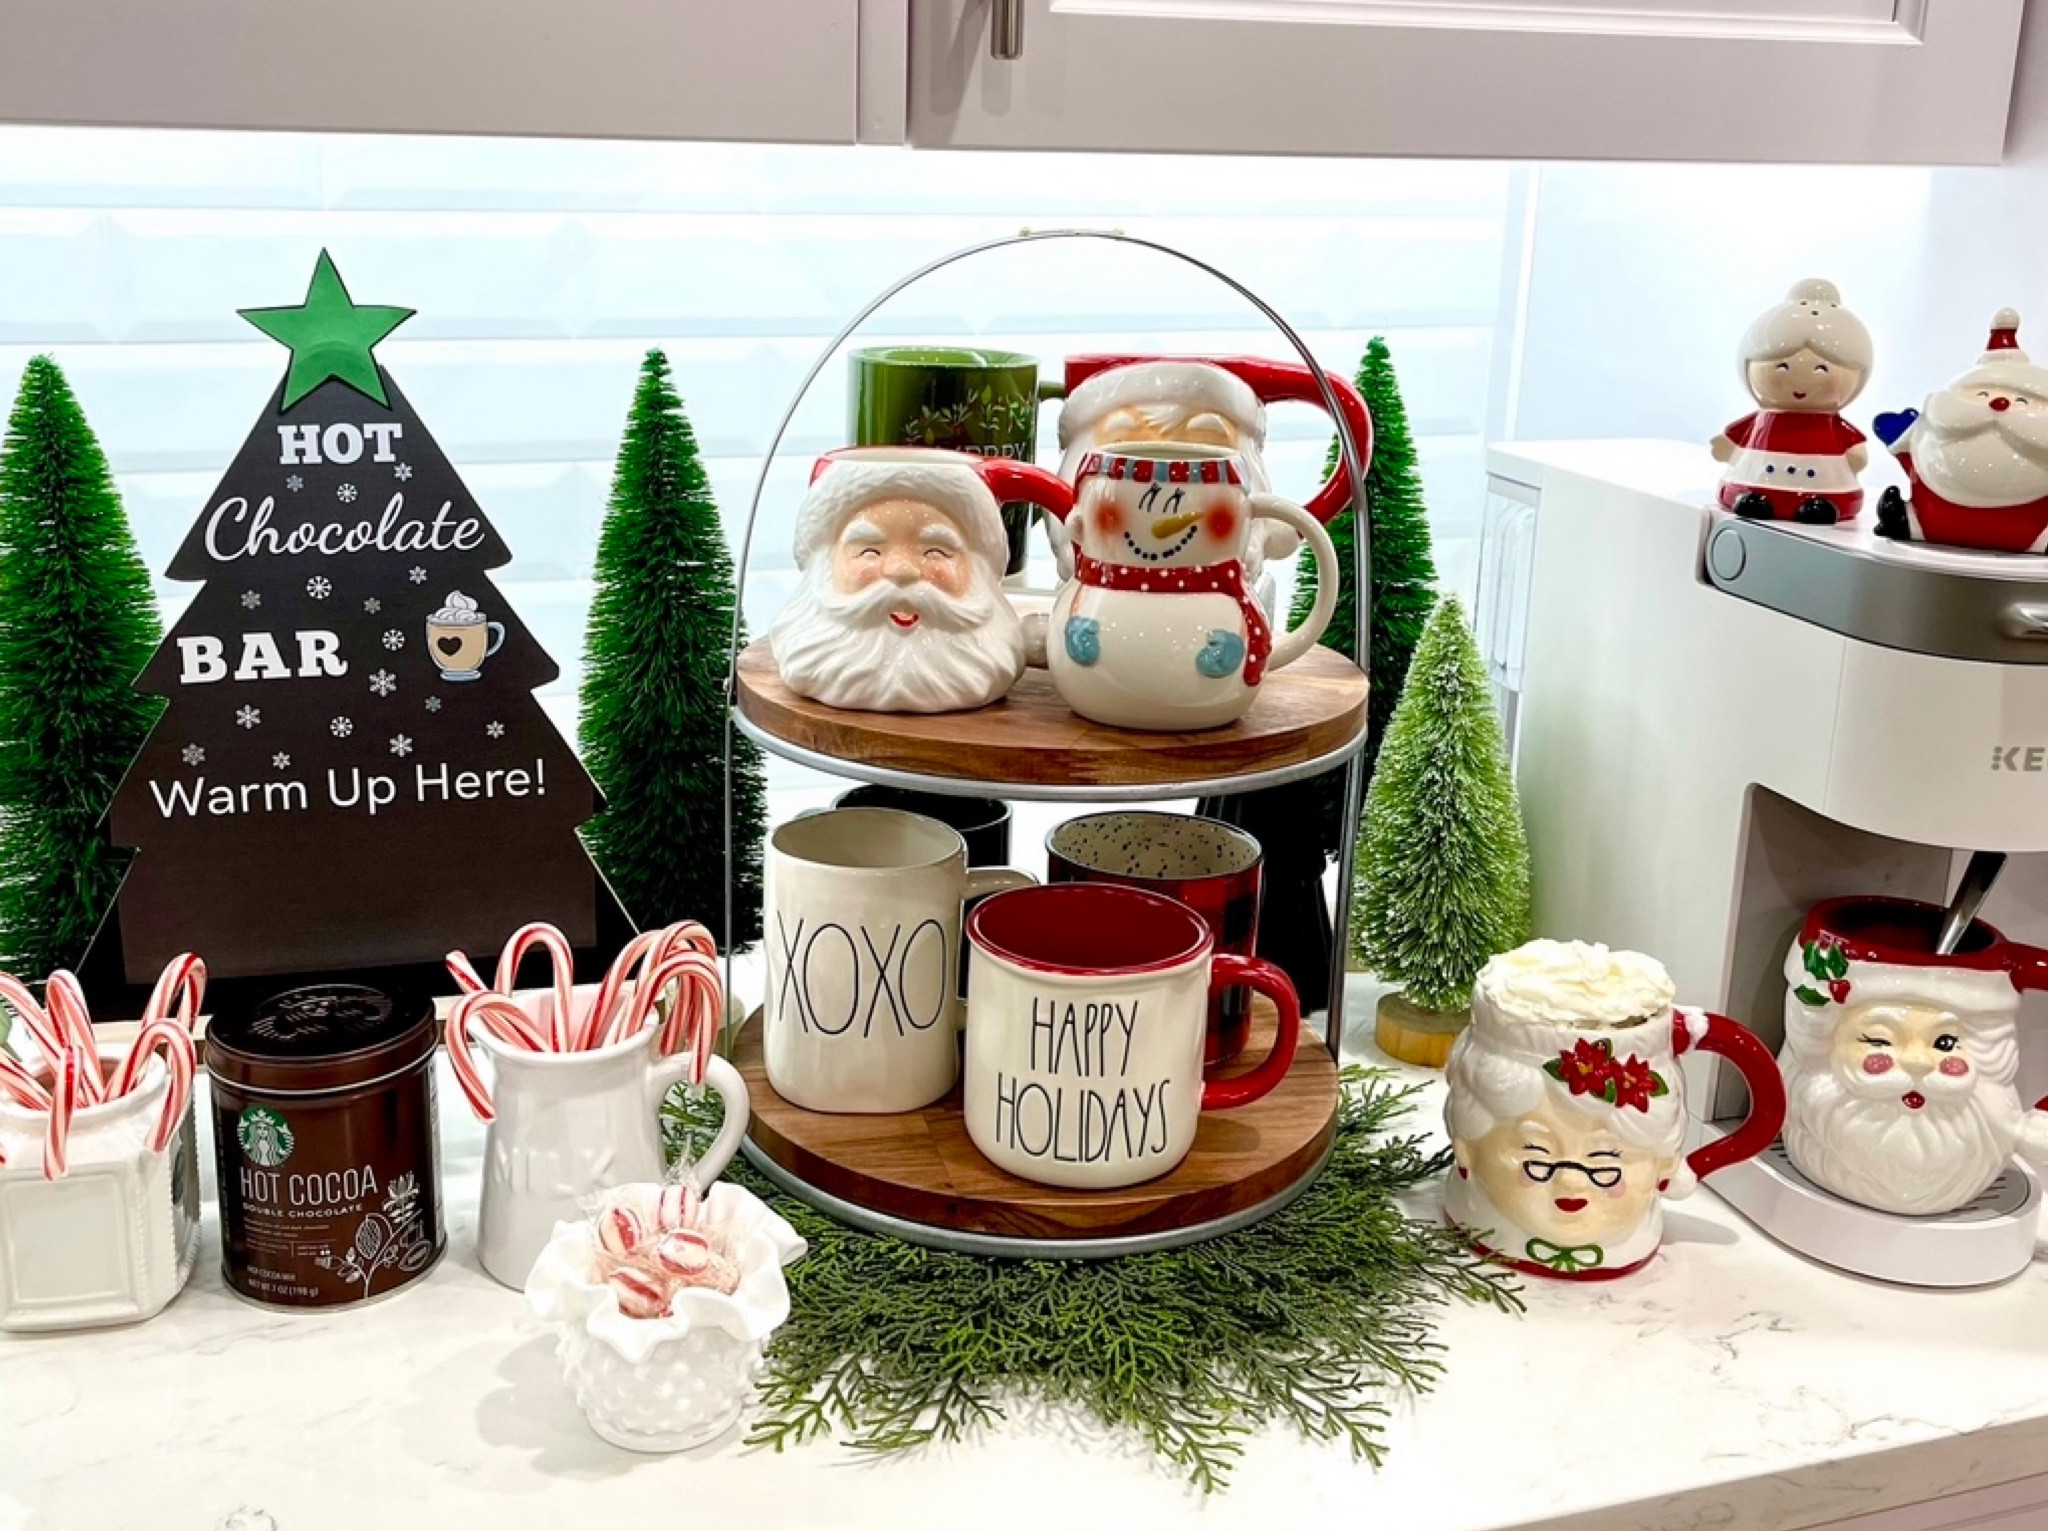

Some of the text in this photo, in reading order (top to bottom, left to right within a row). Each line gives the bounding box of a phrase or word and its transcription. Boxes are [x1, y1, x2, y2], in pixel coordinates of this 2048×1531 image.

[277, 422, 403, 465] HOT
[204, 492, 486, 561] Chocolate
[176, 629, 349, 684] BAR
[1991, 746, 2048, 771] KE
[149, 758, 547, 818] Warm Up Here!
[777, 909, 947, 1039] XOXO
[1031, 997, 1138, 1077] HAPPY
[995, 1071, 1172, 1163] HOLIDAYS
[240, 1164, 379, 1206] HOT COCOA
[242, 1202, 362, 1218] DOUBLE CHOCOLATE
